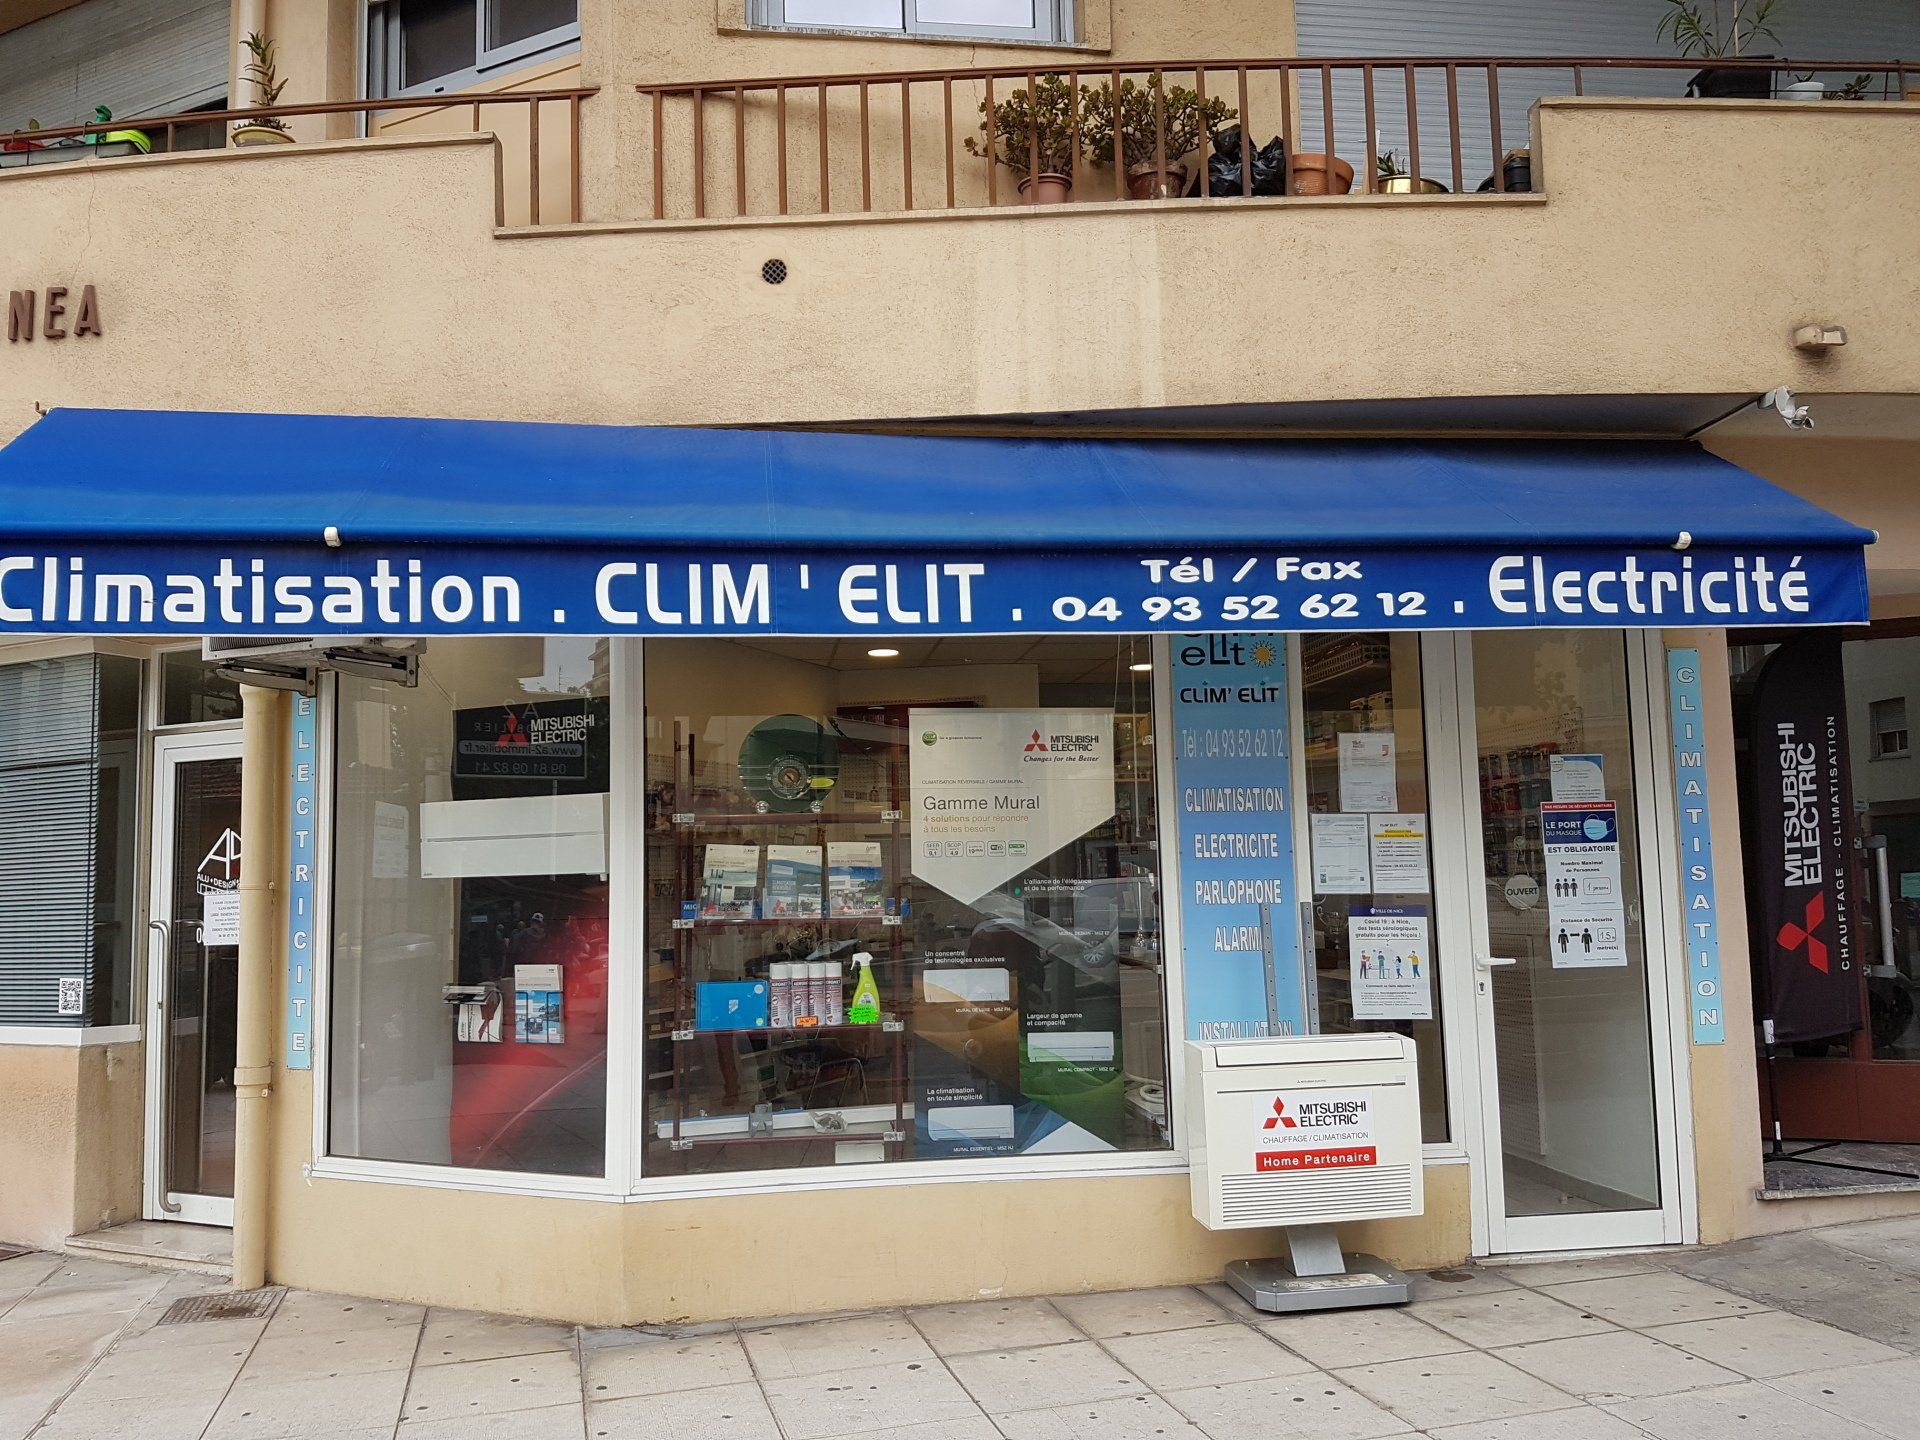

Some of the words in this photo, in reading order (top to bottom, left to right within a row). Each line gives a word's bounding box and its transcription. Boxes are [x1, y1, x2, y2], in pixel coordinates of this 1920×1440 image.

[8, 284, 101, 341] NEA
[1140, 556, 1214, 584] Tél
[1231, 557, 1258, 583] /
[1276, 556, 1363, 582] Fax
[0, 556, 520, 624] Climatisation
[1051, 595, 1123, 622] 04
[1141, 595, 1202, 622] 93
[1220, 594, 1280, 621] 52
[1299, 592, 1360, 619] 62
[1376, 591, 1427, 617] 12
[1488, 555, 1811, 614] Electricité
[1237, 687, 1279, 703] ELIT
[530, 714, 595, 733] MITSUBISHI
[530, 728, 587, 745] ELECTRIC
[1050, 735, 1099, 744] MITSUBISHI
[1205, 729, 1219, 757] 04
[1221, 729, 1235, 757] 93
[1238, 729, 1252, 757] 52
[1254, 729, 1268, 757] 62
[1271, 728, 1284, 757] 12
[1050, 743, 1093, 752] ELECTRIC
[1023, 754, 1052, 762] Changes
[1826, 716, 1843, 847] CLIMATISATION
[923, 796, 988, 811] Gamme
[994, 795, 1040, 810] Mural
[1184, 787, 1284, 812] CLIMATISATION
[1777, 722, 1803, 887] MITSUBISHI
[930, 814, 970, 822] solutions
[1796, 741, 1823, 886] ELECTRIC
[1194, 833, 1279, 858] ELECTRICITE
[1676, 667, 1719, 1026] CLIMATISATION
[213, 876, 236, 889] DESIGN
[292, 697, 311, 1053] ELECTRICITE
[1194, 879, 1282, 905] PARLOPHONE
[1506, 887, 1538, 896] OUVERT
[1835, 866, 1850, 971] CHAUFFAGE
[1299, 1101, 1366, 1115] MITSUBISHI
[1300, 1114, 1359, 1128] ELECTRIC
[1262, 1135, 1308, 1144] CHAUFFAGE
[1313, 1132, 1369, 1142] CLIMATISATION
[1264, 1157, 1299, 1168] Home
[1304, 1152, 1370, 1165] Partenaire
